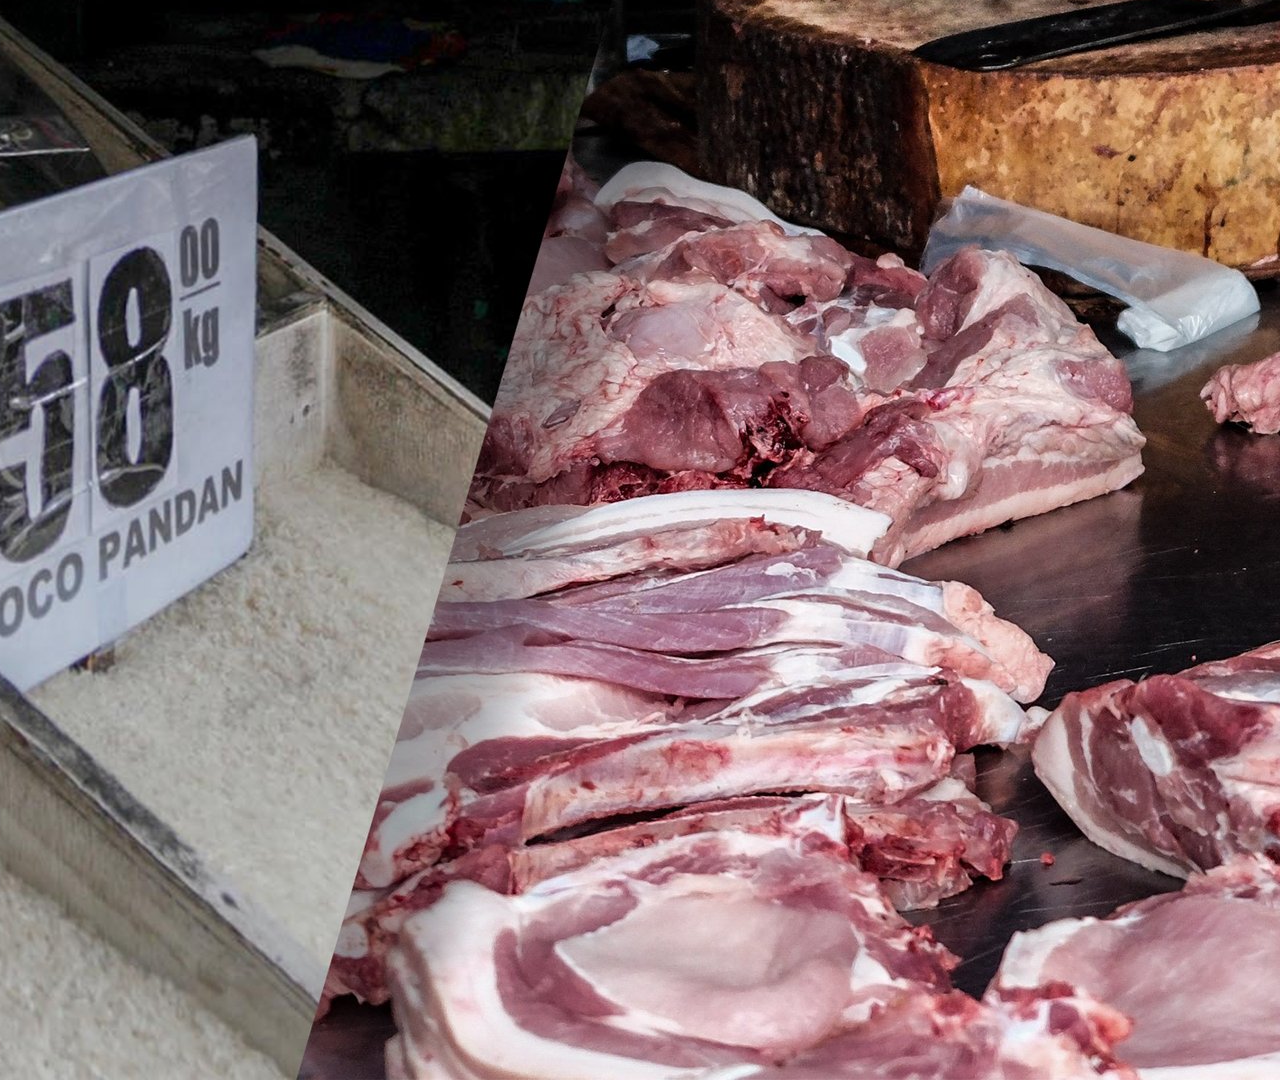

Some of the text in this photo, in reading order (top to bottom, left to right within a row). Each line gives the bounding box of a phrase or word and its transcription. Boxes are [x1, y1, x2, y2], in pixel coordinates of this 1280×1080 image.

[180, 217, 220, 289] 00
[183, 304, 220, 370] kg
[97, 459, 244, 581] PANDAN
